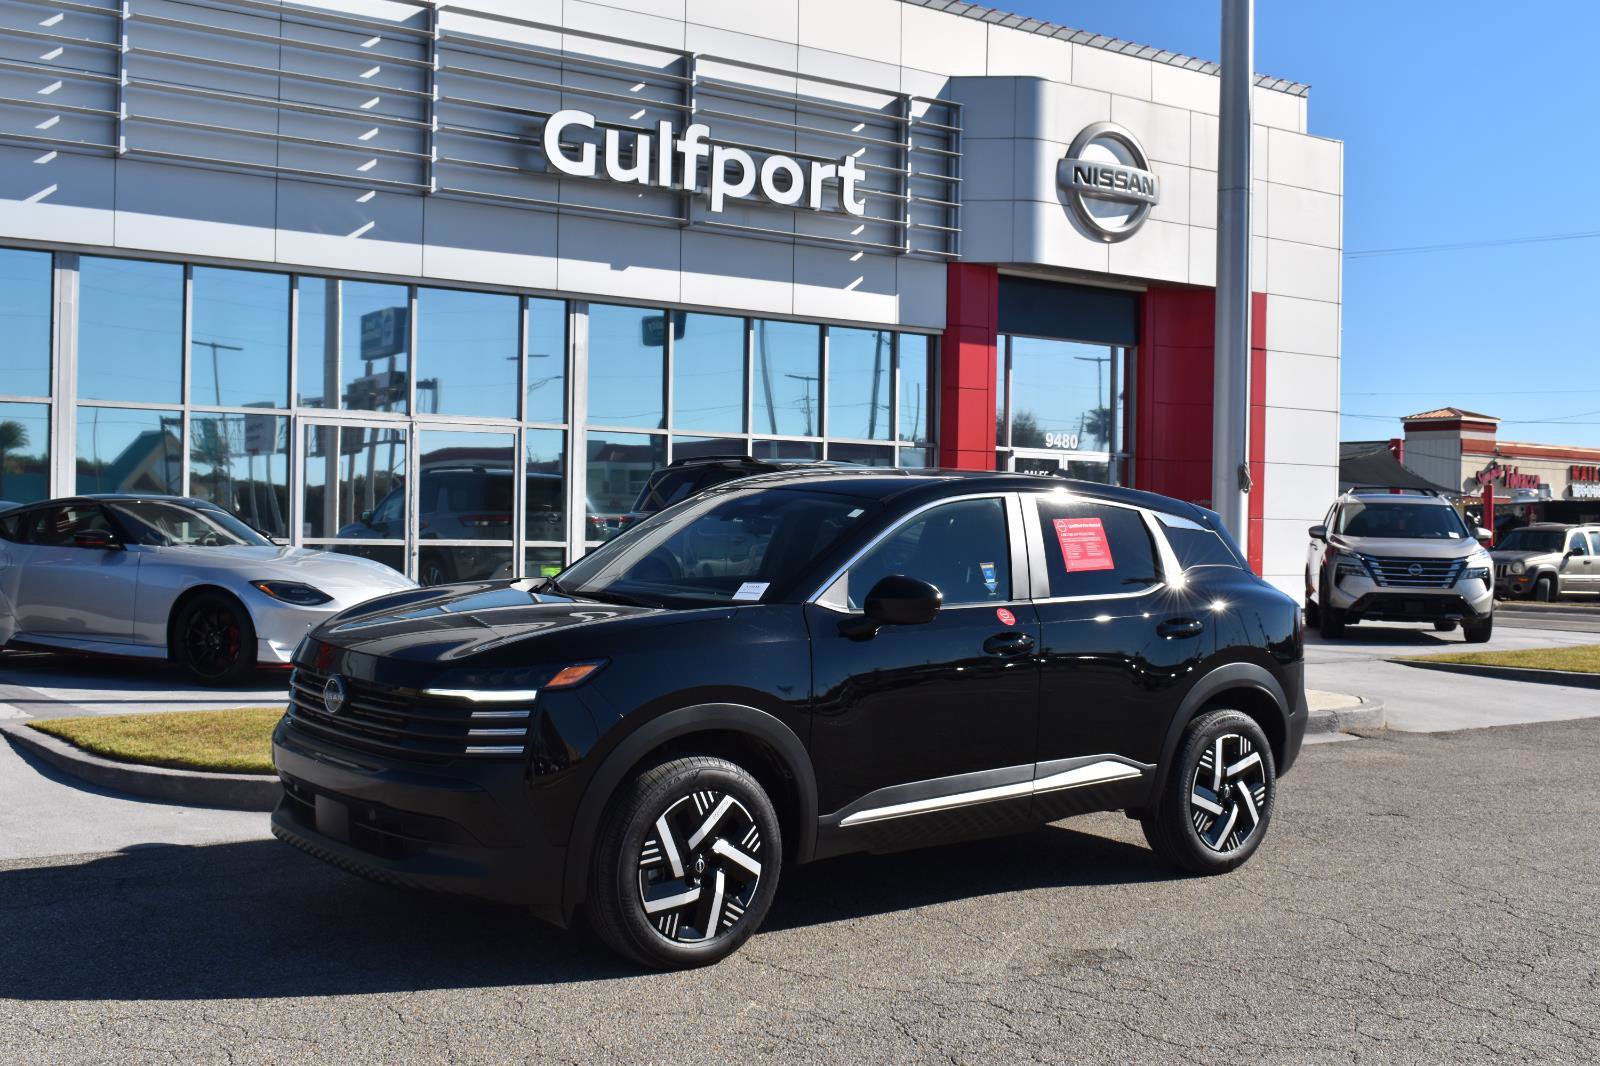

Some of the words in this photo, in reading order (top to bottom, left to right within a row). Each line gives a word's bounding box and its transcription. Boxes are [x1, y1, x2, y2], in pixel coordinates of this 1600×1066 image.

[544, 109, 866, 215] Gulfport
[1073, 165, 1154, 198] NISSAN
[1045, 432, 1079, 449] 9480
